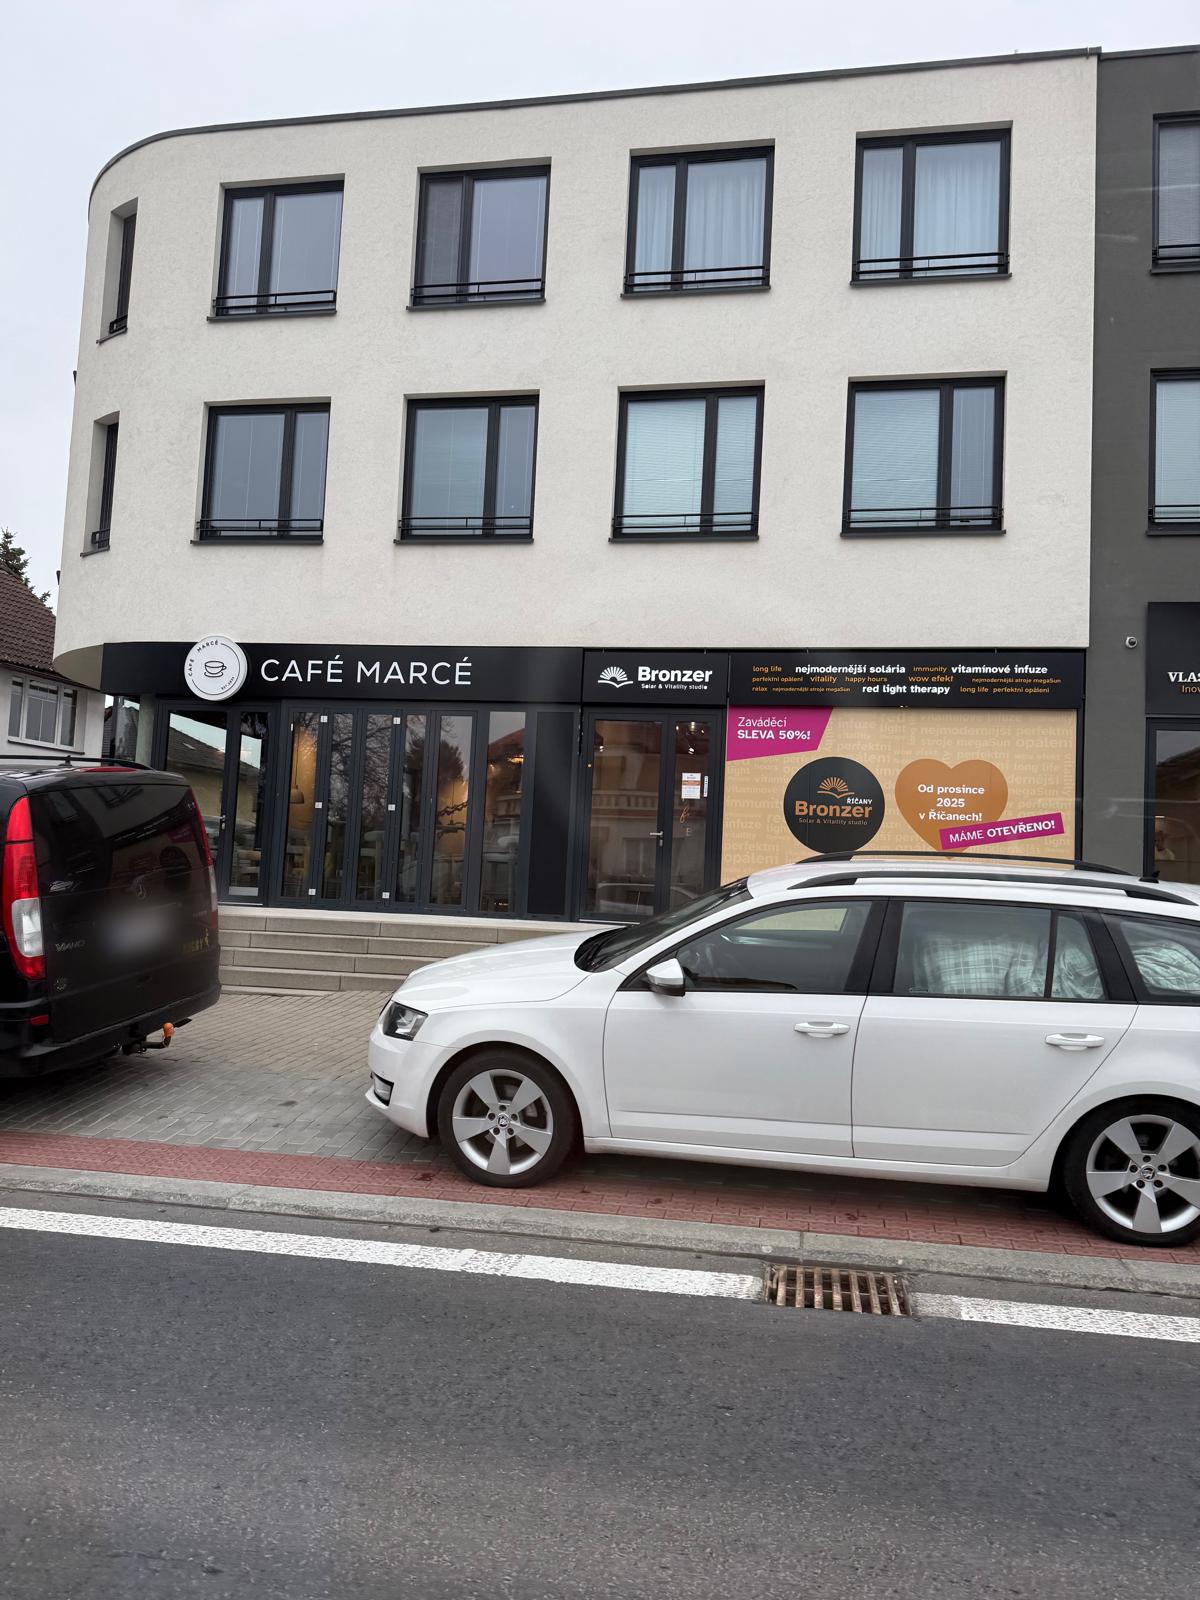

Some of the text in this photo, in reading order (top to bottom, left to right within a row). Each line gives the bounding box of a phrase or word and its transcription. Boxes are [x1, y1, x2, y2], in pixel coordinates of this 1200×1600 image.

[260, 654, 344, 683] CAFÉ
[356, 656, 473, 685] MARCÉ
[637, 665, 713, 683] Bronzer
[752, 665, 769, 673] long
[795, 664, 867, 675] nejmodernější
[869, 664, 906, 674] solária
[913, 665, 948, 673] immunity
[951, 664, 1011, 674] vitamínové
[1013, 664, 1048, 674] infuze
[810, 675, 837, 684] vitality
[931, 674, 954, 682] efekt
[862, 684, 880, 693] red
[882, 684, 907, 695] light
[910, 684, 951, 695] therapy
[960, 686, 976, 694] long
[737, 716, 787, 728] Zaváděcí
[737, 729, 811, 740] SLEVA 50%!
[917, 784, 985, 796] Od prosince
[936, 797, 966, 808] 2025
[795, 800, 873, 818] Bronzer
[918, 809, 983, 822] v Říčanech!
[949, 819, 1056, 843] MÁME OTEVŘENO!
